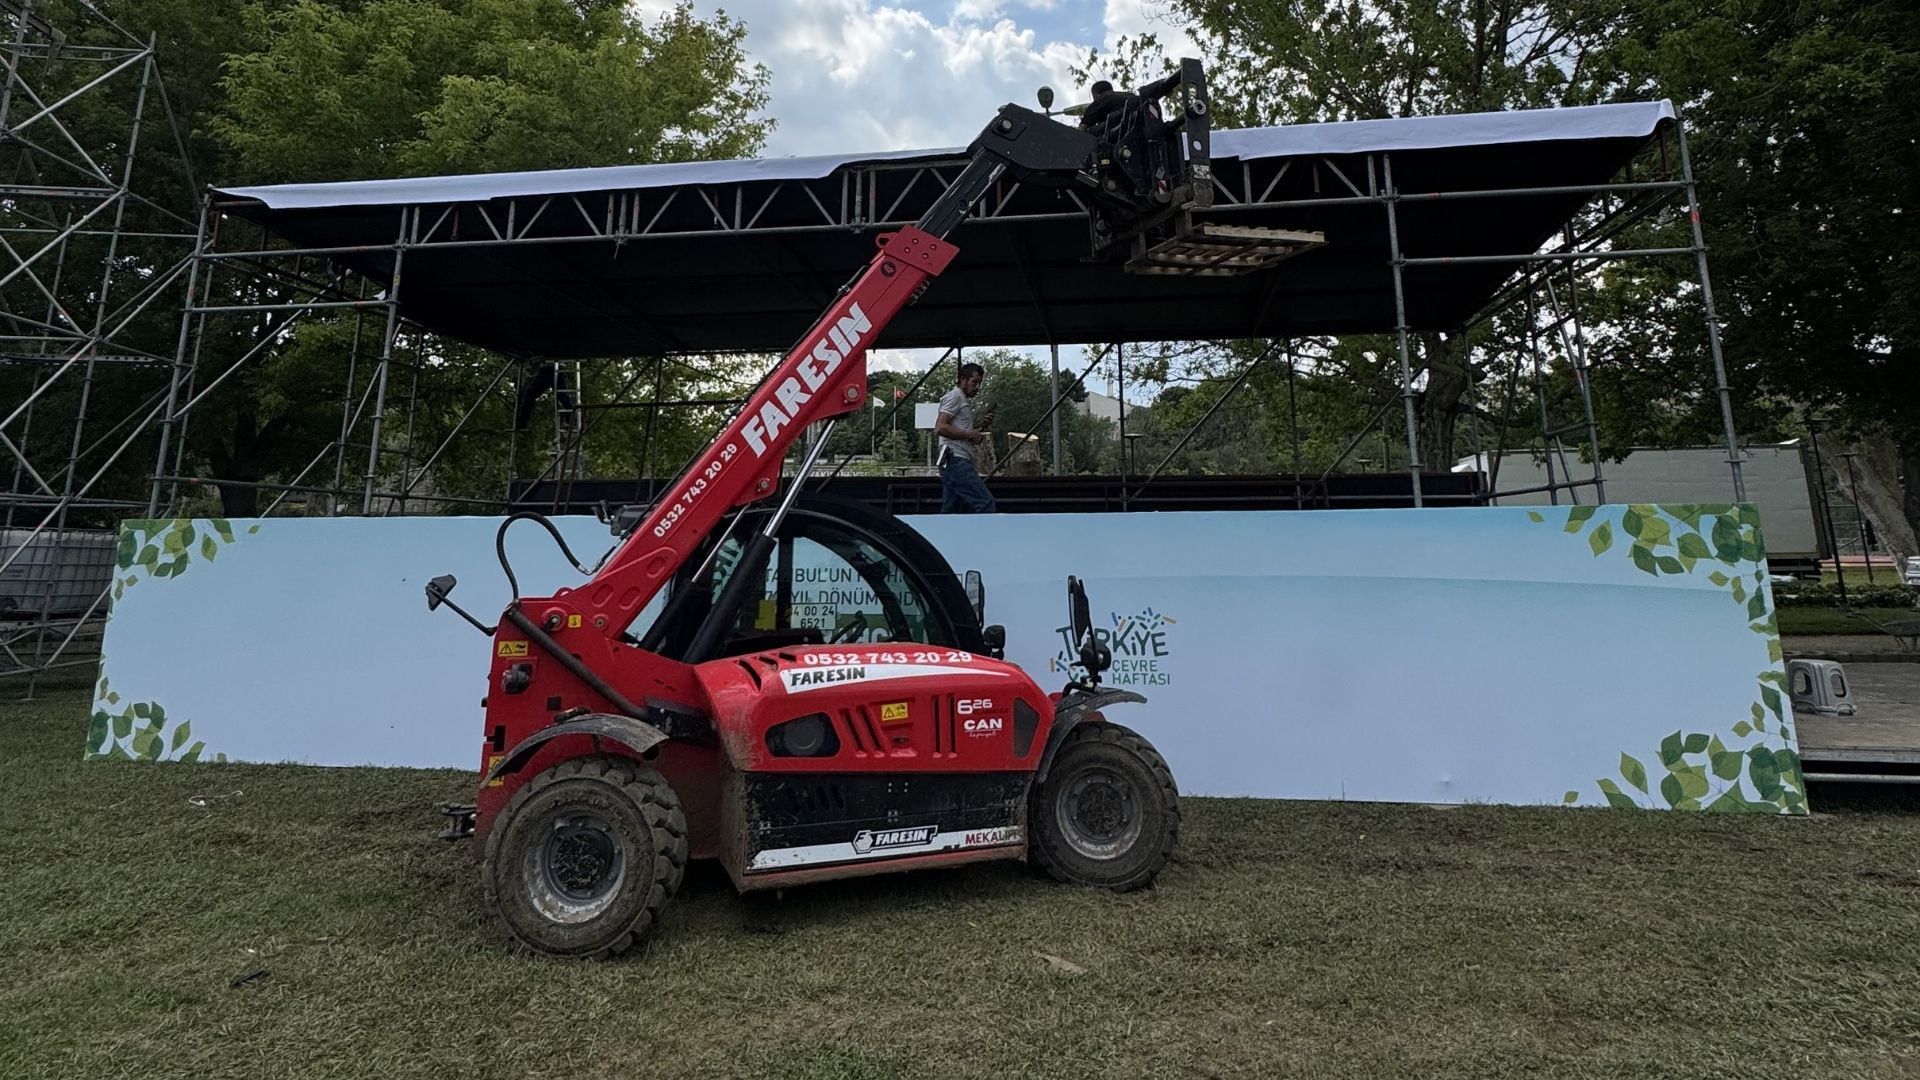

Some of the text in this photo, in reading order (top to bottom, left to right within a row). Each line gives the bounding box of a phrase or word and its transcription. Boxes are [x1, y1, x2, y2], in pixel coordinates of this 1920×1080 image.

[740, 301, 873, 459] FARESIN
[653, 443, 737, 537] 0532 743 20 29
[822, 605, 835, 616] 24
[800, 618, 826, 628] 6521
[803, 651, 972, 665] 0532 743 20 29
[1112, 659, 1158, 673] ÇEVRE
[791, 666, 866, 686] FARESIN
[1112, 673, 1171, 685] HAFTASI
[963, 718, 1003, 731] CAN
[875, 828, 928, 845] FARESIN
